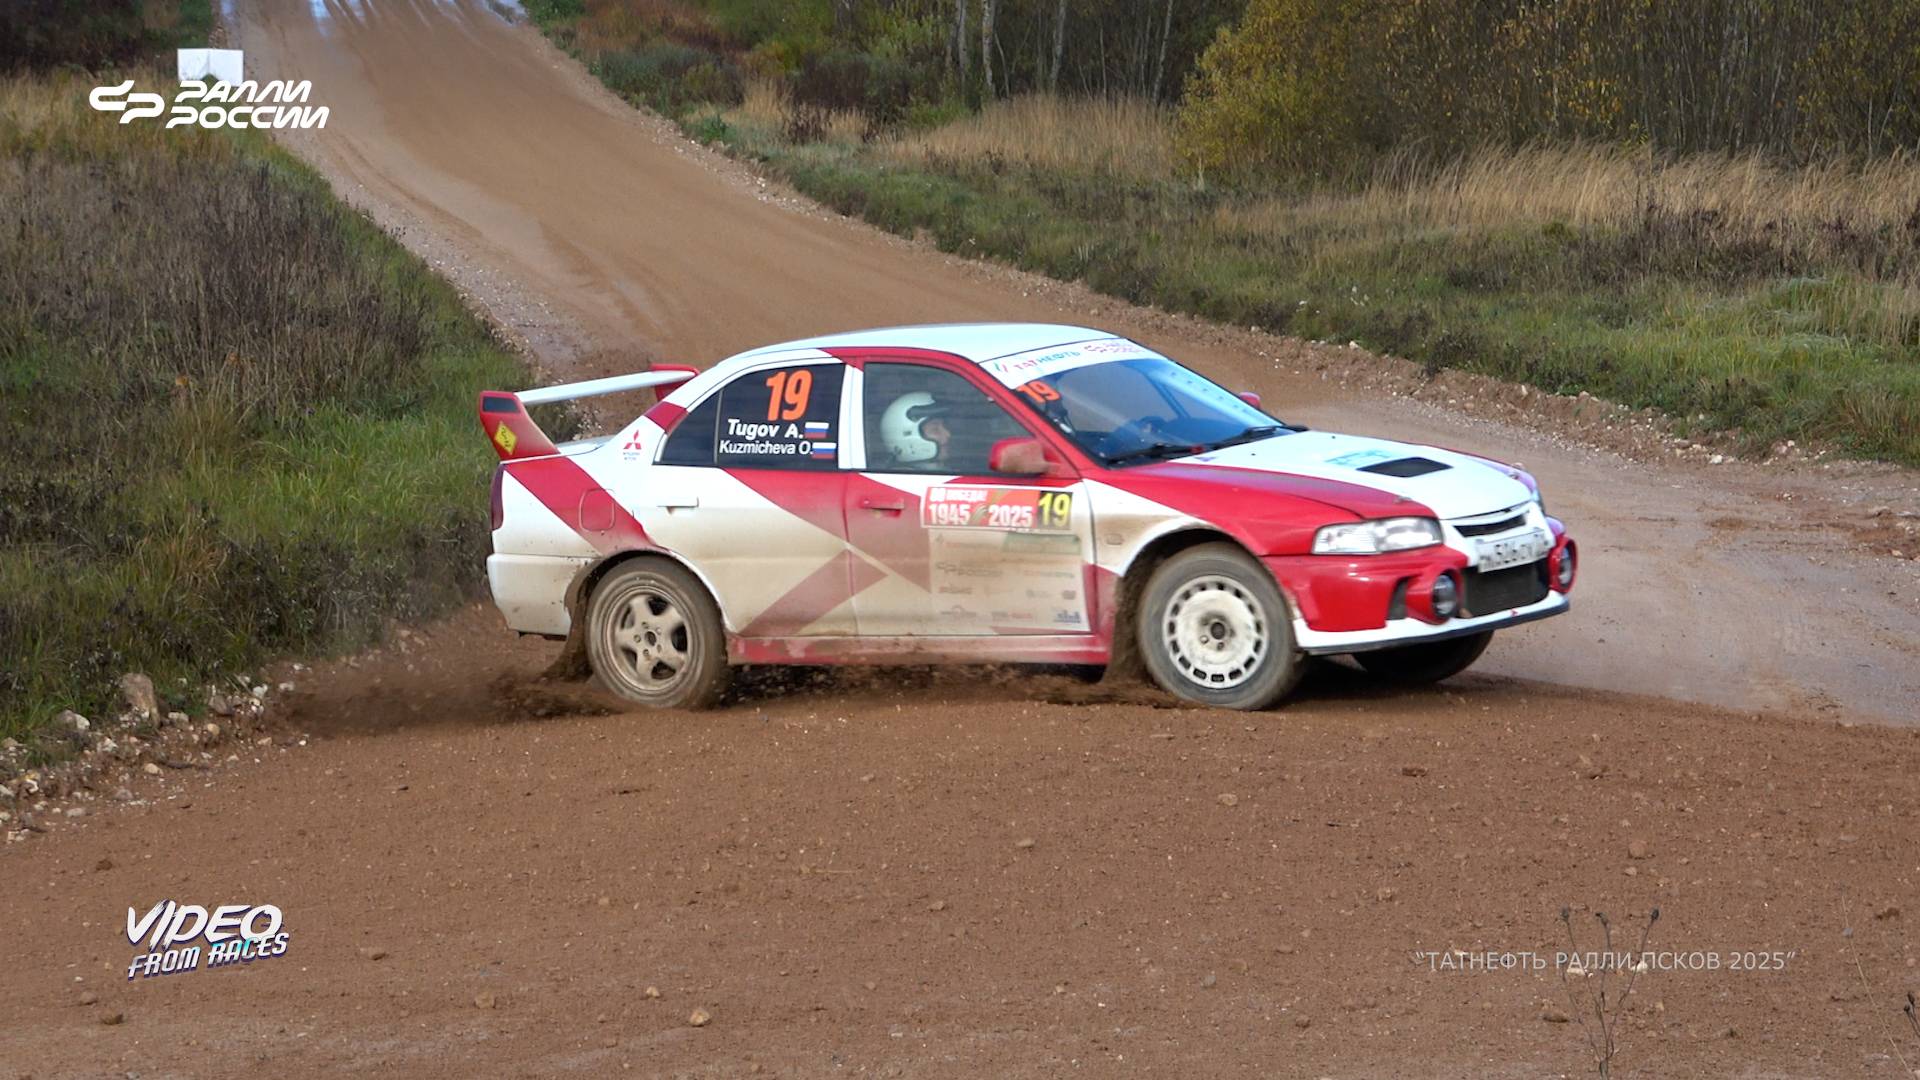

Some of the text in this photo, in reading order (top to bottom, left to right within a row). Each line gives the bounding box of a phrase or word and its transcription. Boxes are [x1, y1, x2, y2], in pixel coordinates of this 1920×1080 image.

[766, 369, 813, 422] 19
[1016, 380, 1061, 404] 19
[727, 418, 804, 441] Tugov A.
[719, 440, 813, 455] Kuzmicheva O.
[928, 503, 1033, 527] 1945 2025
[1038, 493, 1071, 528] 19
